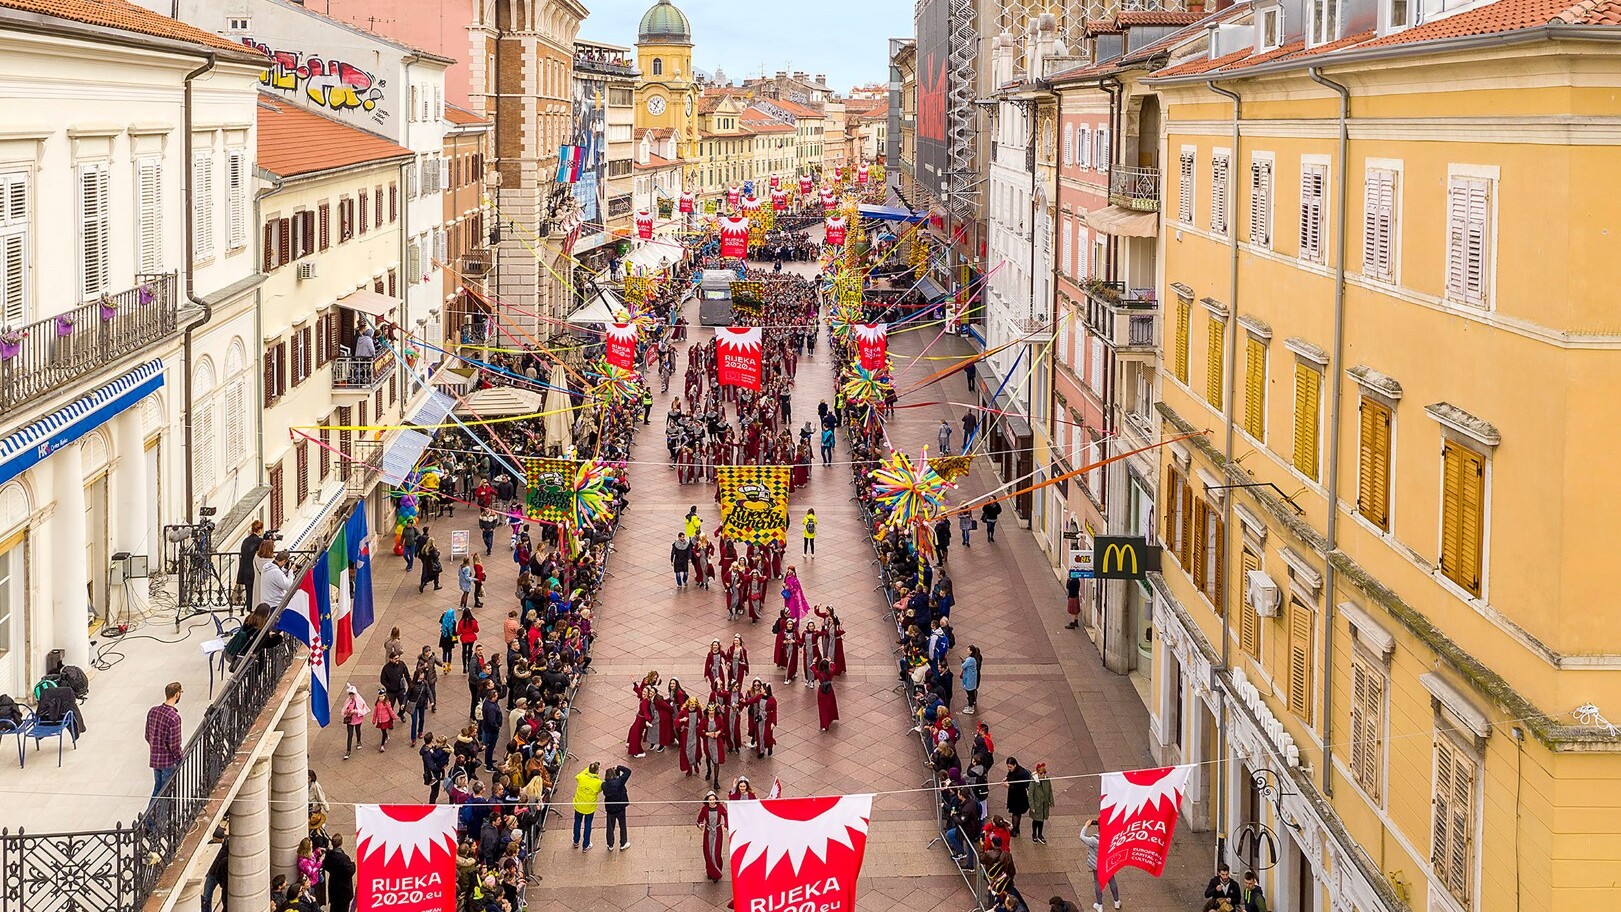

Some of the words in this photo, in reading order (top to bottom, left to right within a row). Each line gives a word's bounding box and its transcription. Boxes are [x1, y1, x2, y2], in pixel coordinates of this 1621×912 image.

[724, 354, 756, 366] RIJEKA
[1111, 820, 1167, 845] RIJEKA
[372, 872, 442, 892] RIJEKA
[371, 890, 442, 908] 2020.eu
[750, 876, 840, 912] RIJEKA
